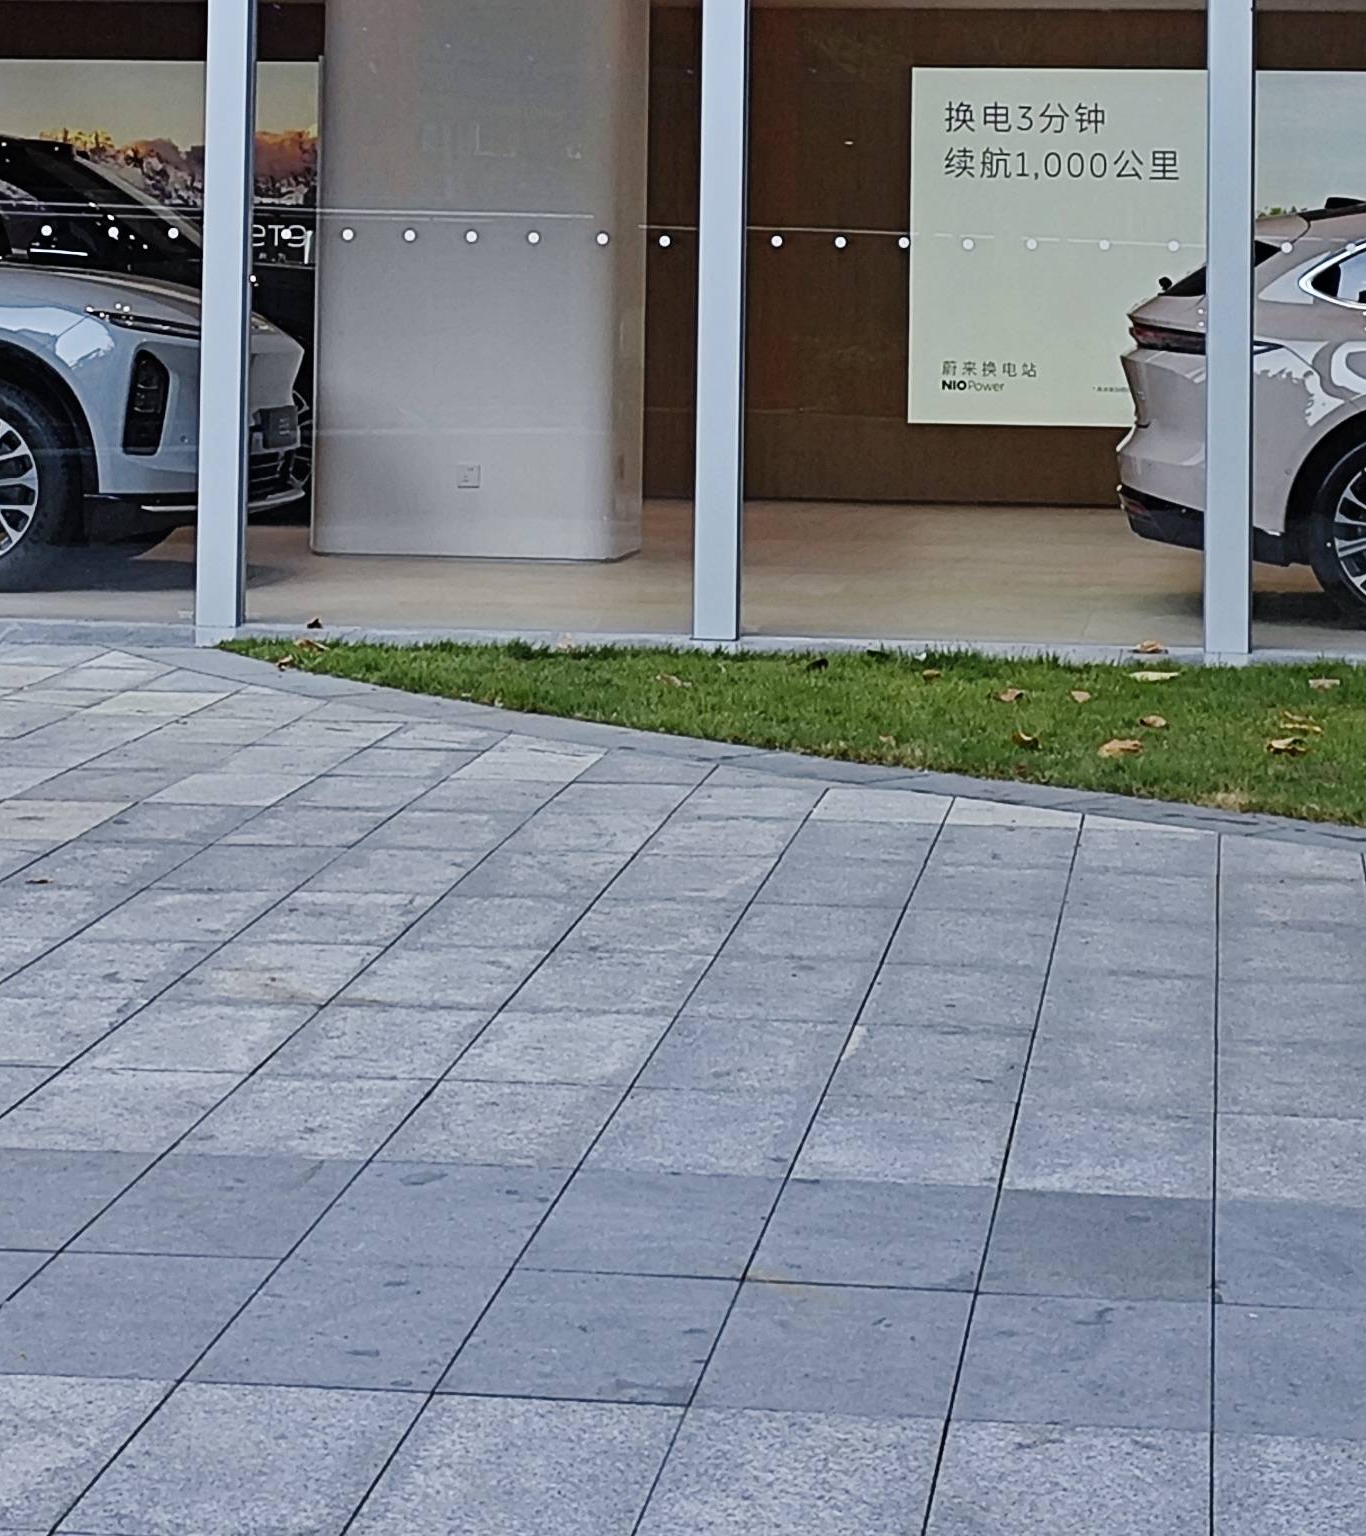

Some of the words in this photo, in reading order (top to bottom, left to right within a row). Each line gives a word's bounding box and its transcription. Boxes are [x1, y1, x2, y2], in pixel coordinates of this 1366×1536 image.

[944, 101, 1106, 134] 换电3分钟
[943, 146, 1180, 182] 续航1,000公里
[941, 360, 1038, 378] 蔚来换电站
